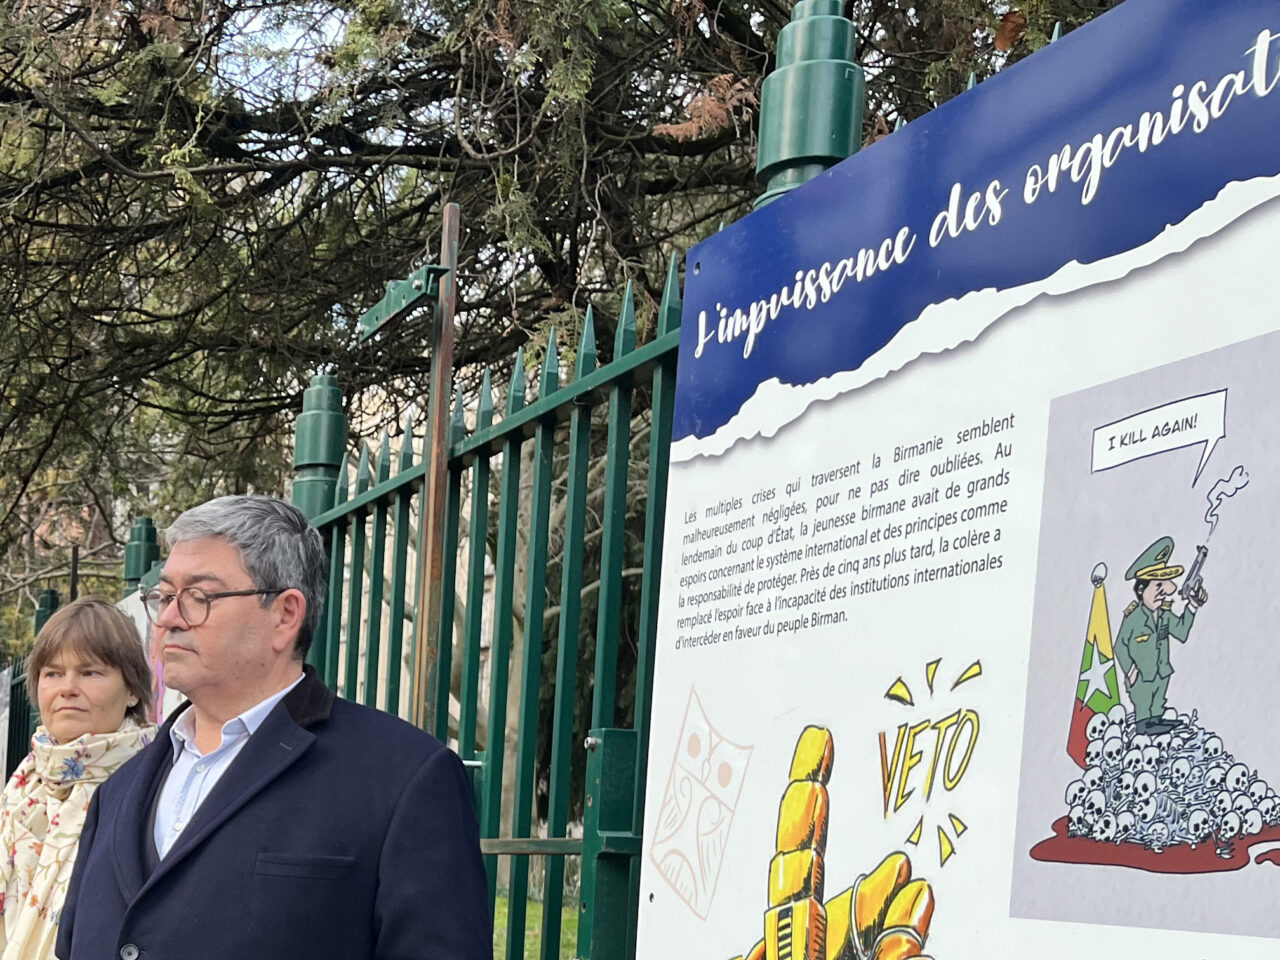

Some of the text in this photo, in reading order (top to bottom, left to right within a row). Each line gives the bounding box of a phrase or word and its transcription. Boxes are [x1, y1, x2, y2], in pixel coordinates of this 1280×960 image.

[694, 222, 916, 358] L'impuissance
[929, 183, 1008, 248] des
[685, 413, 1015, 524] Les multiples crises qui traversent la Birmanie semblent
[1108, 413, 1198, 451] I KILL AGAIN!
[680, 500, 1007, 588] espoirs concernant le système international et des principes comme
[683, 442, 1012, 544] malheureusement négligées, pour ne pas dire oubliées. Au
[676, 611, 847, 649] d'intercéder en faveur du peuple Birman.
[878, 708, 980, 820] VETO
